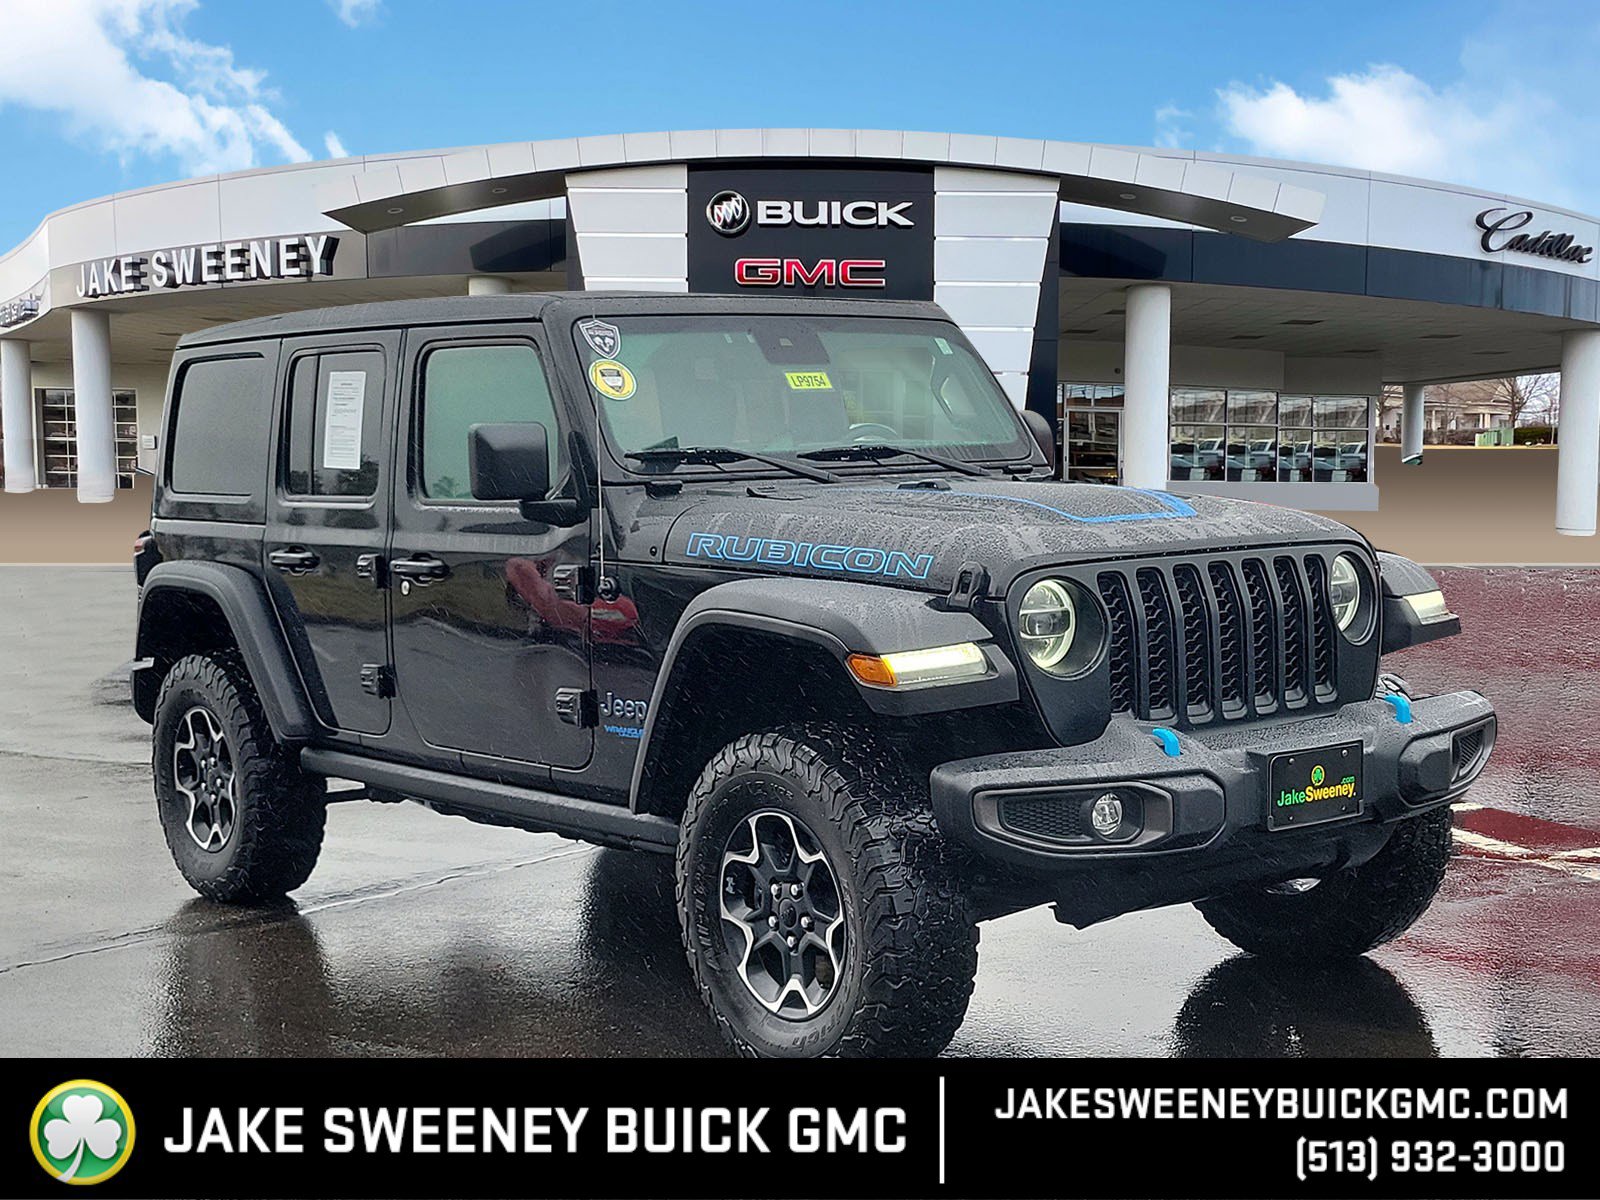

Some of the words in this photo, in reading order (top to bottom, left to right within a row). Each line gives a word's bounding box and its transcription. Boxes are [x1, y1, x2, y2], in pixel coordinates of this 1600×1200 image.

[757, 200, 915, 226] BUICK
[1475, 207, 1593, 263] Cadillac
[76, 256, 142, 298] JAKE
[151, 235, 333, 288] SWEENEY
[735, 258, 885, 287] GMC
[790, 375, 826, 387] LP9754
[686, 533, 934, 579] RUBICON
[600, 692, 647, 722] Jeep
[1277, 783, 1354, 806] JakeSweeney
